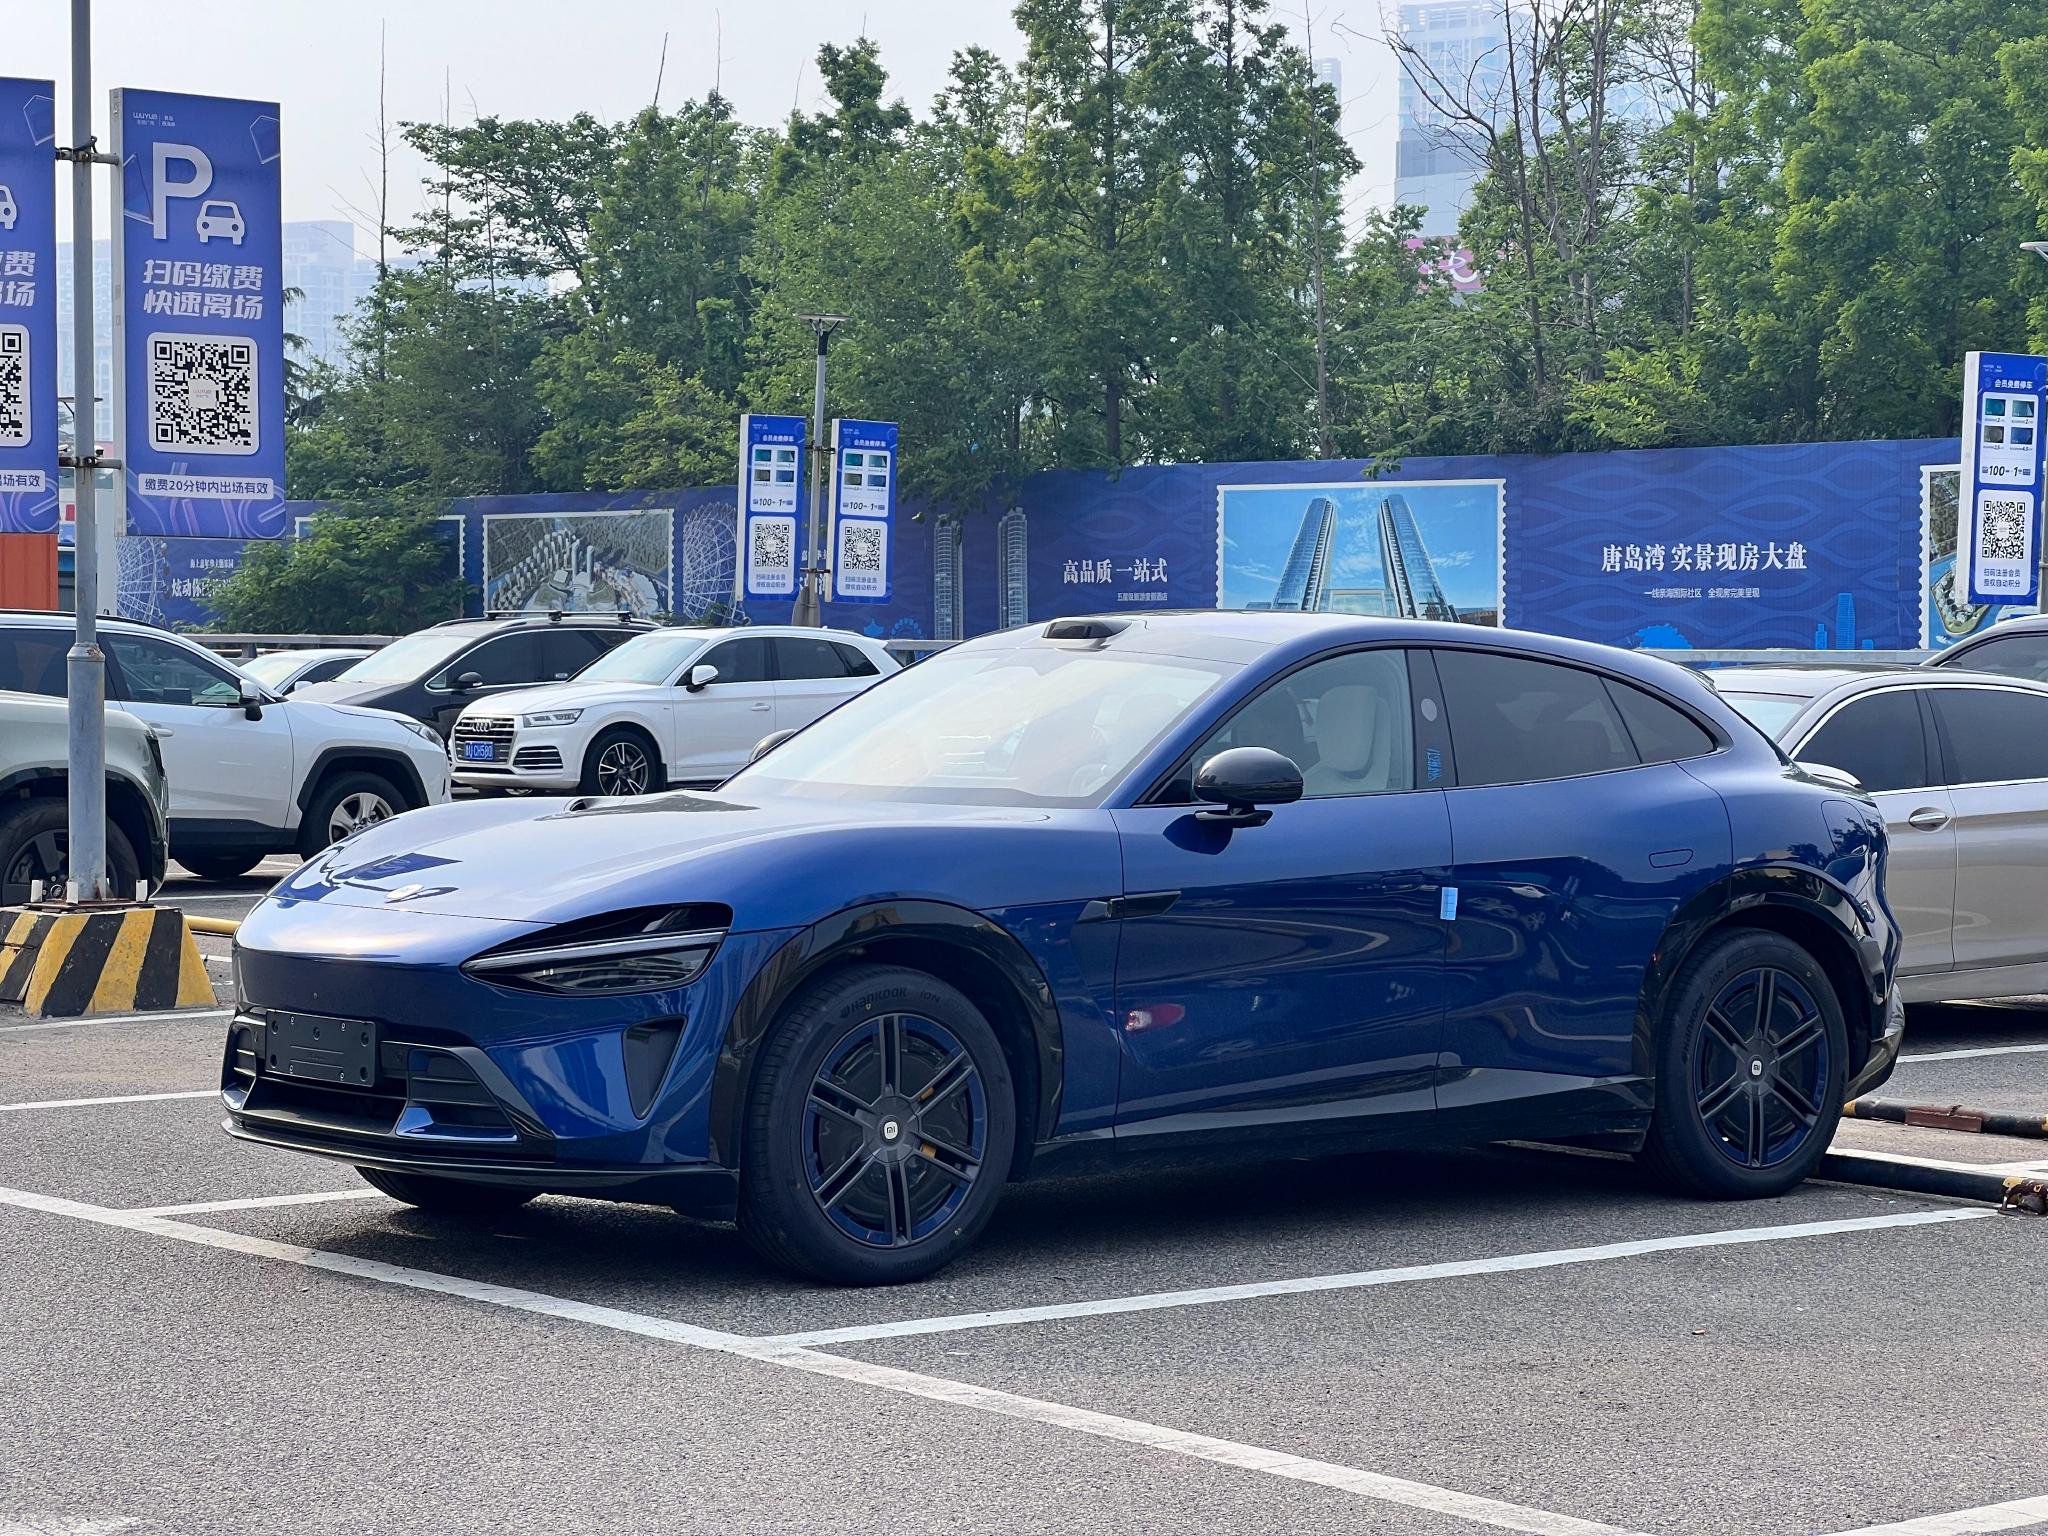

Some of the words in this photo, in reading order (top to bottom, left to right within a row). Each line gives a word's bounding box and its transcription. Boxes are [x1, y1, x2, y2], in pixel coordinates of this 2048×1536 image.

[153, 142, 213, 240] P
[0, 251, 36, 277] 费
[143, 259, 263, 291] 扫码缴费
[0, 281, 36, 307] 场
[143, 289, 264, 320] 快速离场
[0, 474, 40, 487] 场有效
[145, 478, 268, 494] 缴费20分钟内出场有效
[1063, 558, 1112, 584] 高品质
[1116, 557, 1168, 583] 一站式
[1601, 543, 1666, 573] 唐岛湾
[1670, 541, 1808, 572] 实景现房大盘
